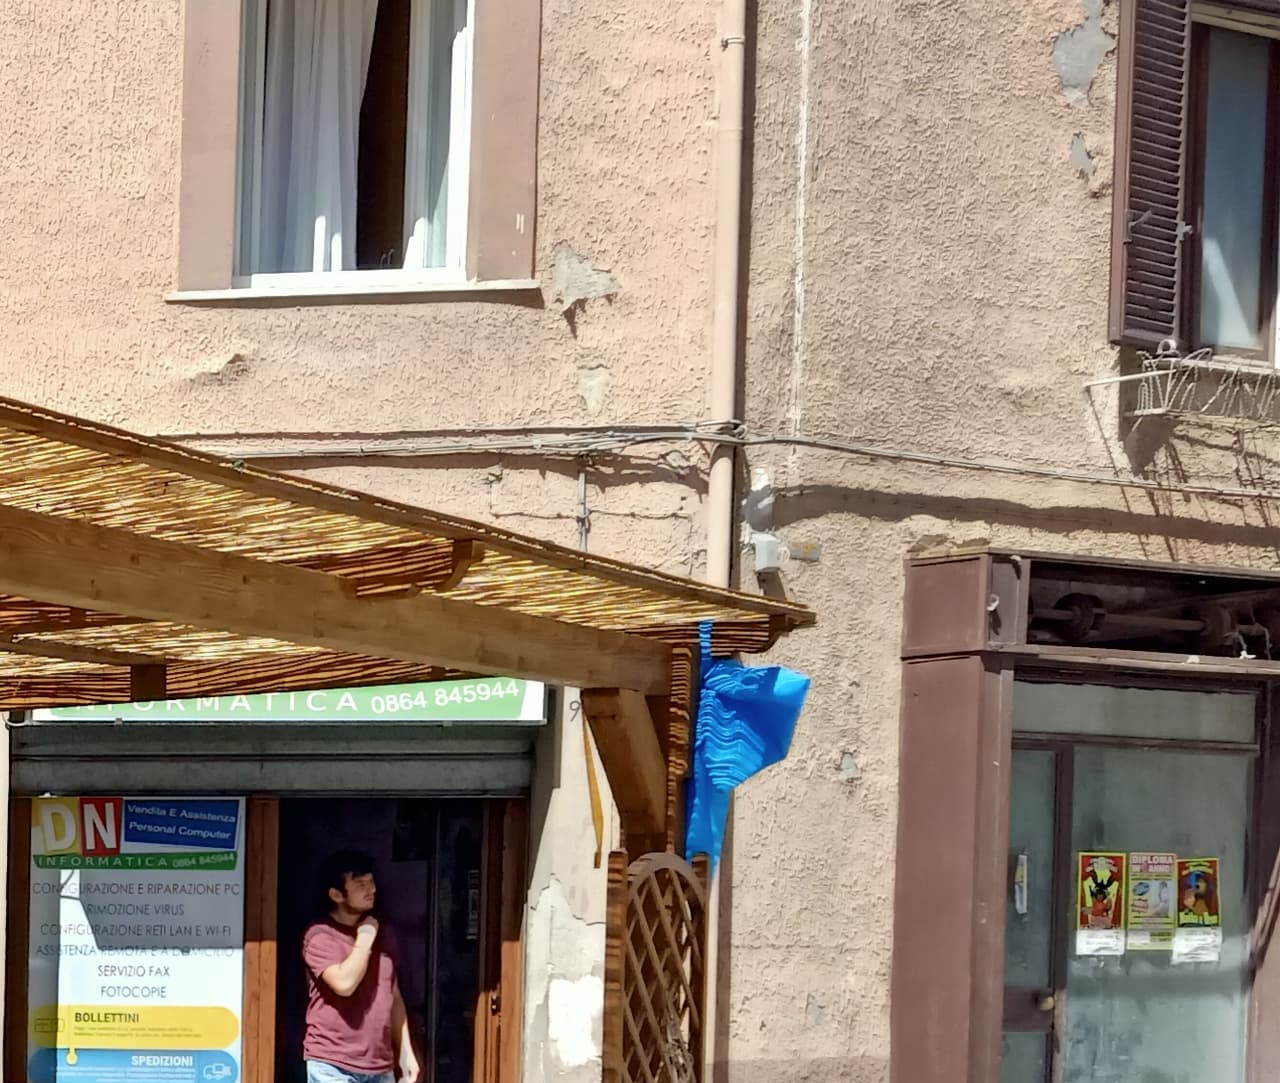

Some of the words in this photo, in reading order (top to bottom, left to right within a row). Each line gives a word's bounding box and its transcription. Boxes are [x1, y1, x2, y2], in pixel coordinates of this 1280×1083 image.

[370, 690, 428, 714] 0864
[434, 678, 519, 707] 845944
[128, 804, 167, 817] Vendita
[169, 808, 177, 817] E
[180, 809, 237, 823] Assistenza
[42, 802, 118, 851] DN
[129, 821, 176, 834] Personal
[178, 826, 232, 840] Computer
[39, 855, 168, 867] INFORMATICA
[1131, 855, 1174, 864] DIPLOMA
[32, 883, 137, 895] CONIGURAZIONE
[138, 883, 144, 895] E
[147, 883, 222, 896] RIPARAZIONE
[225, 883, 241, 896] PC
[88, 903, 150, 915] RIMOZIONE
[154, 903, 185, 915] VIRUS
[40, 923, 142, 937] CONFIGURAZIONE
[145, 924, 167, 936] RETI
[169, 924, 191, 937] LAN
[195, 924, 201, 937] E
[97, 965, 146, 977] SERVIZIO
[148, 966, 171, 977] FAX
[100, 985, 167, 998] FOTOCOPIE
[74, 1012, 140, 1023] BOLLETTINI
[131, 1055, 193, 1067] SPEDIZIONI
